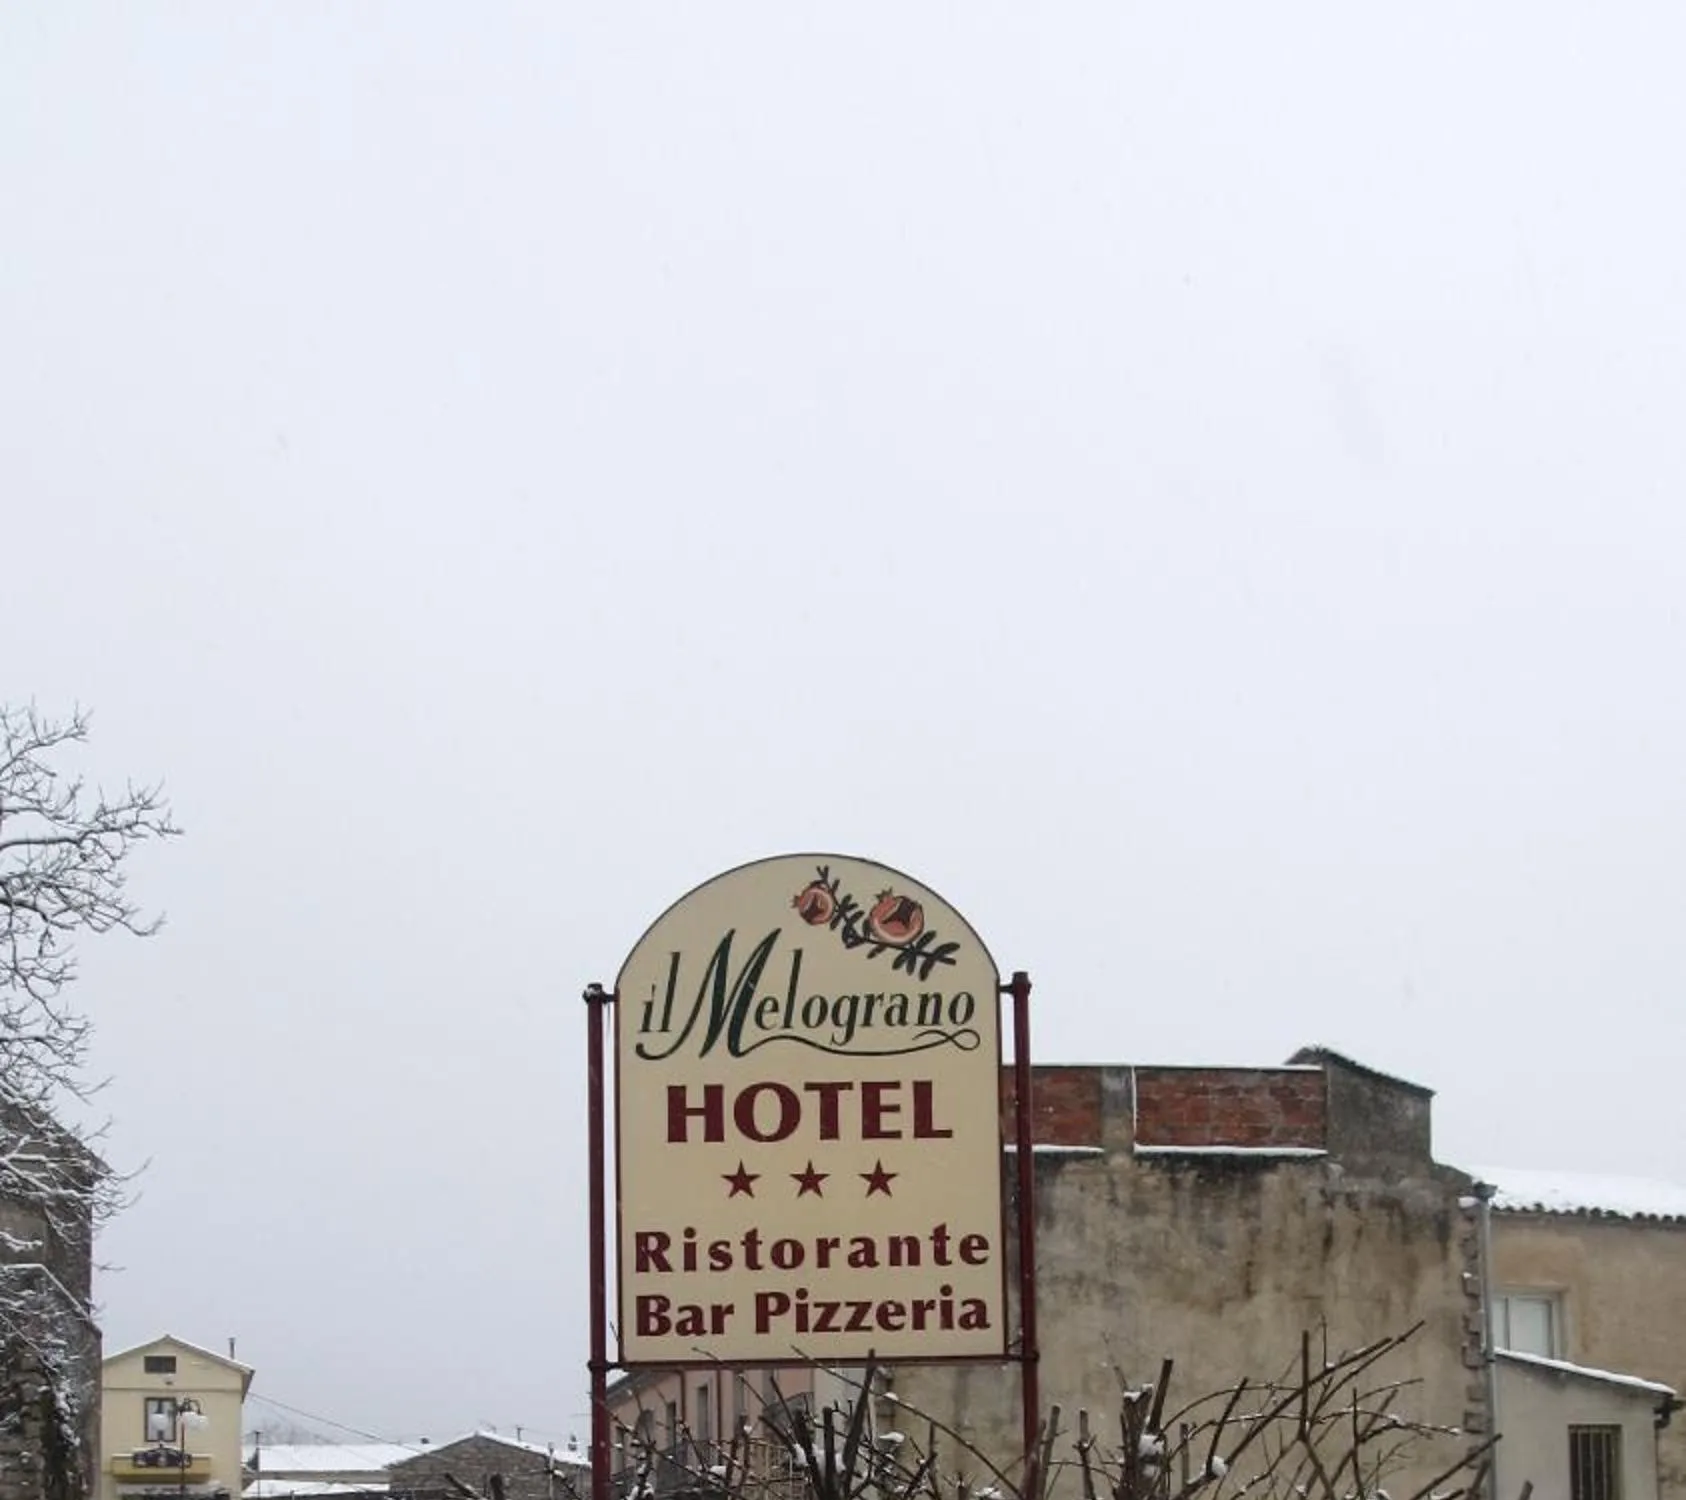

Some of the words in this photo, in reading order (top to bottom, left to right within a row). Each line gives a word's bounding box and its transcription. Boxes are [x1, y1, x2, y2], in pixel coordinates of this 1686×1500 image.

[637, 927, 981, 1060] Melograno
[638, 950, 682, 1034] il
[666, 1079, 954, 1144] HOTEL
[634, 1222, 990, 1274] Ristorante
[635, 1293, 735, 1337] Bar
[753, 1283, 992, 1336] Pizzeria
